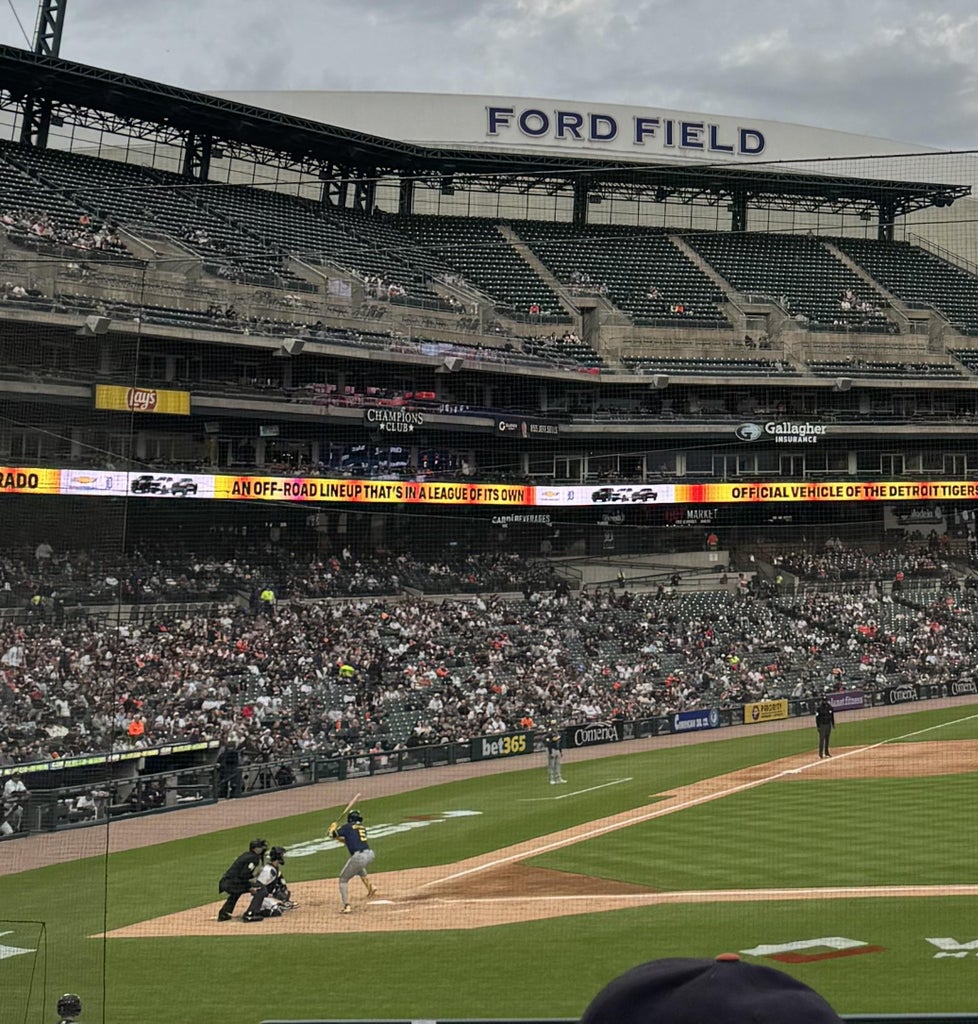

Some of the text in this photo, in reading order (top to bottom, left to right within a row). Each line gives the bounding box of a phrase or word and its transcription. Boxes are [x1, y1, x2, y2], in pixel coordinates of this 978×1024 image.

[485, 106, 766, 156] FORD FIELD
[127, 387, 156, 410] Lay's
[367, 408, 424, 425] CHAMPIONS
[386, 422, 408, 433] CLUB
[765, 422, 828, 436] Gallagher
[231, 480, 524, 501] AN OFF-ROAD LINEUP THAT'S IN A LEAGUE OF ITS OWN
[731, 486, 789, 499] OFFICIAL
[791, 486, 843, 498] VEHICLE
[845, 486, 862, 497] OF
[864, 485, 887, 497] THE
[889, 485, 939, 497] DETROIT
[686, 509, 718, 519] MARKET
[482, 734, 526, 756] bet365
